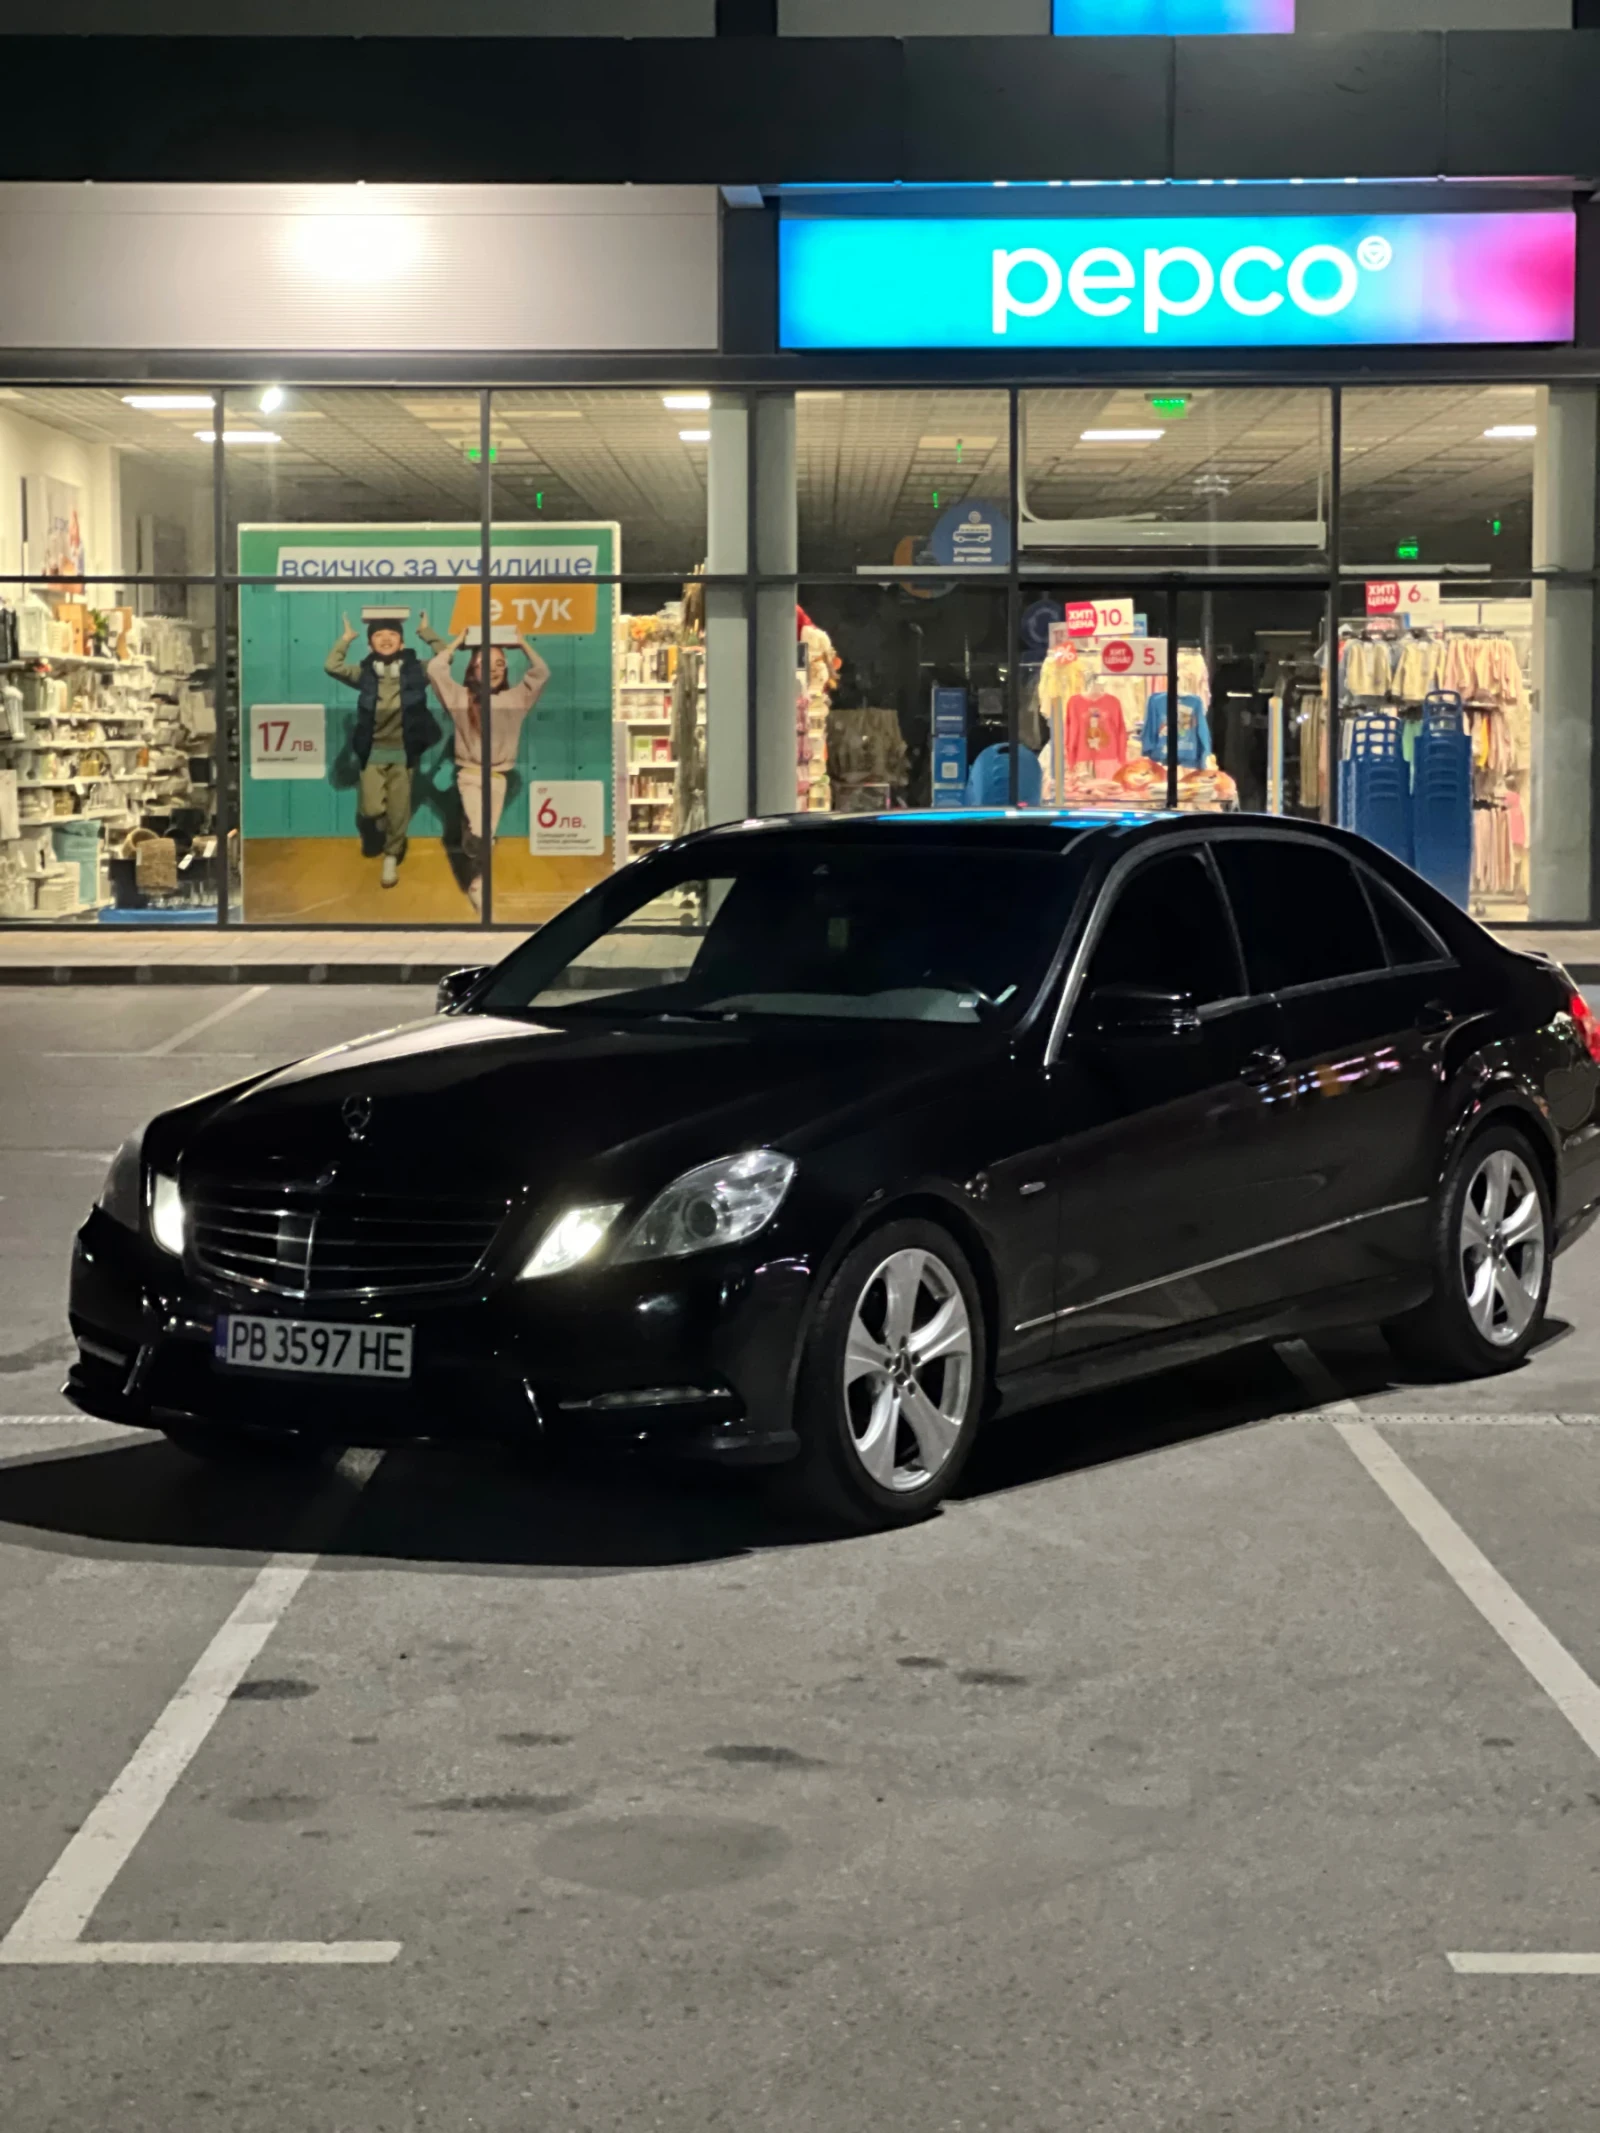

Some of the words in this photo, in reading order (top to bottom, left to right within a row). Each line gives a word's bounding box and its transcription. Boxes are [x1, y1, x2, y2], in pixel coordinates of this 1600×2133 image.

[992, 244, 1358, 333] pepco
[281, 558, 395, 577] всичко
[404, 558, 438, 577] за
[447, 557, 594, 577] училище
[1408, 584, 1421, 603] 6
[490, 598, 504, 621] е
[511, 598, 573, 629] тук
[1100, 608, 1122, 627] 10
[1143, 647, 1155, 666] 5
[257, 721, 290, 752] 17
[290, 740, 318, 753] лв.
[537, 797, 557, 829] 6
[558, 816, 586, 829] лв.
[272, 1325, 352, 1368] 3597
